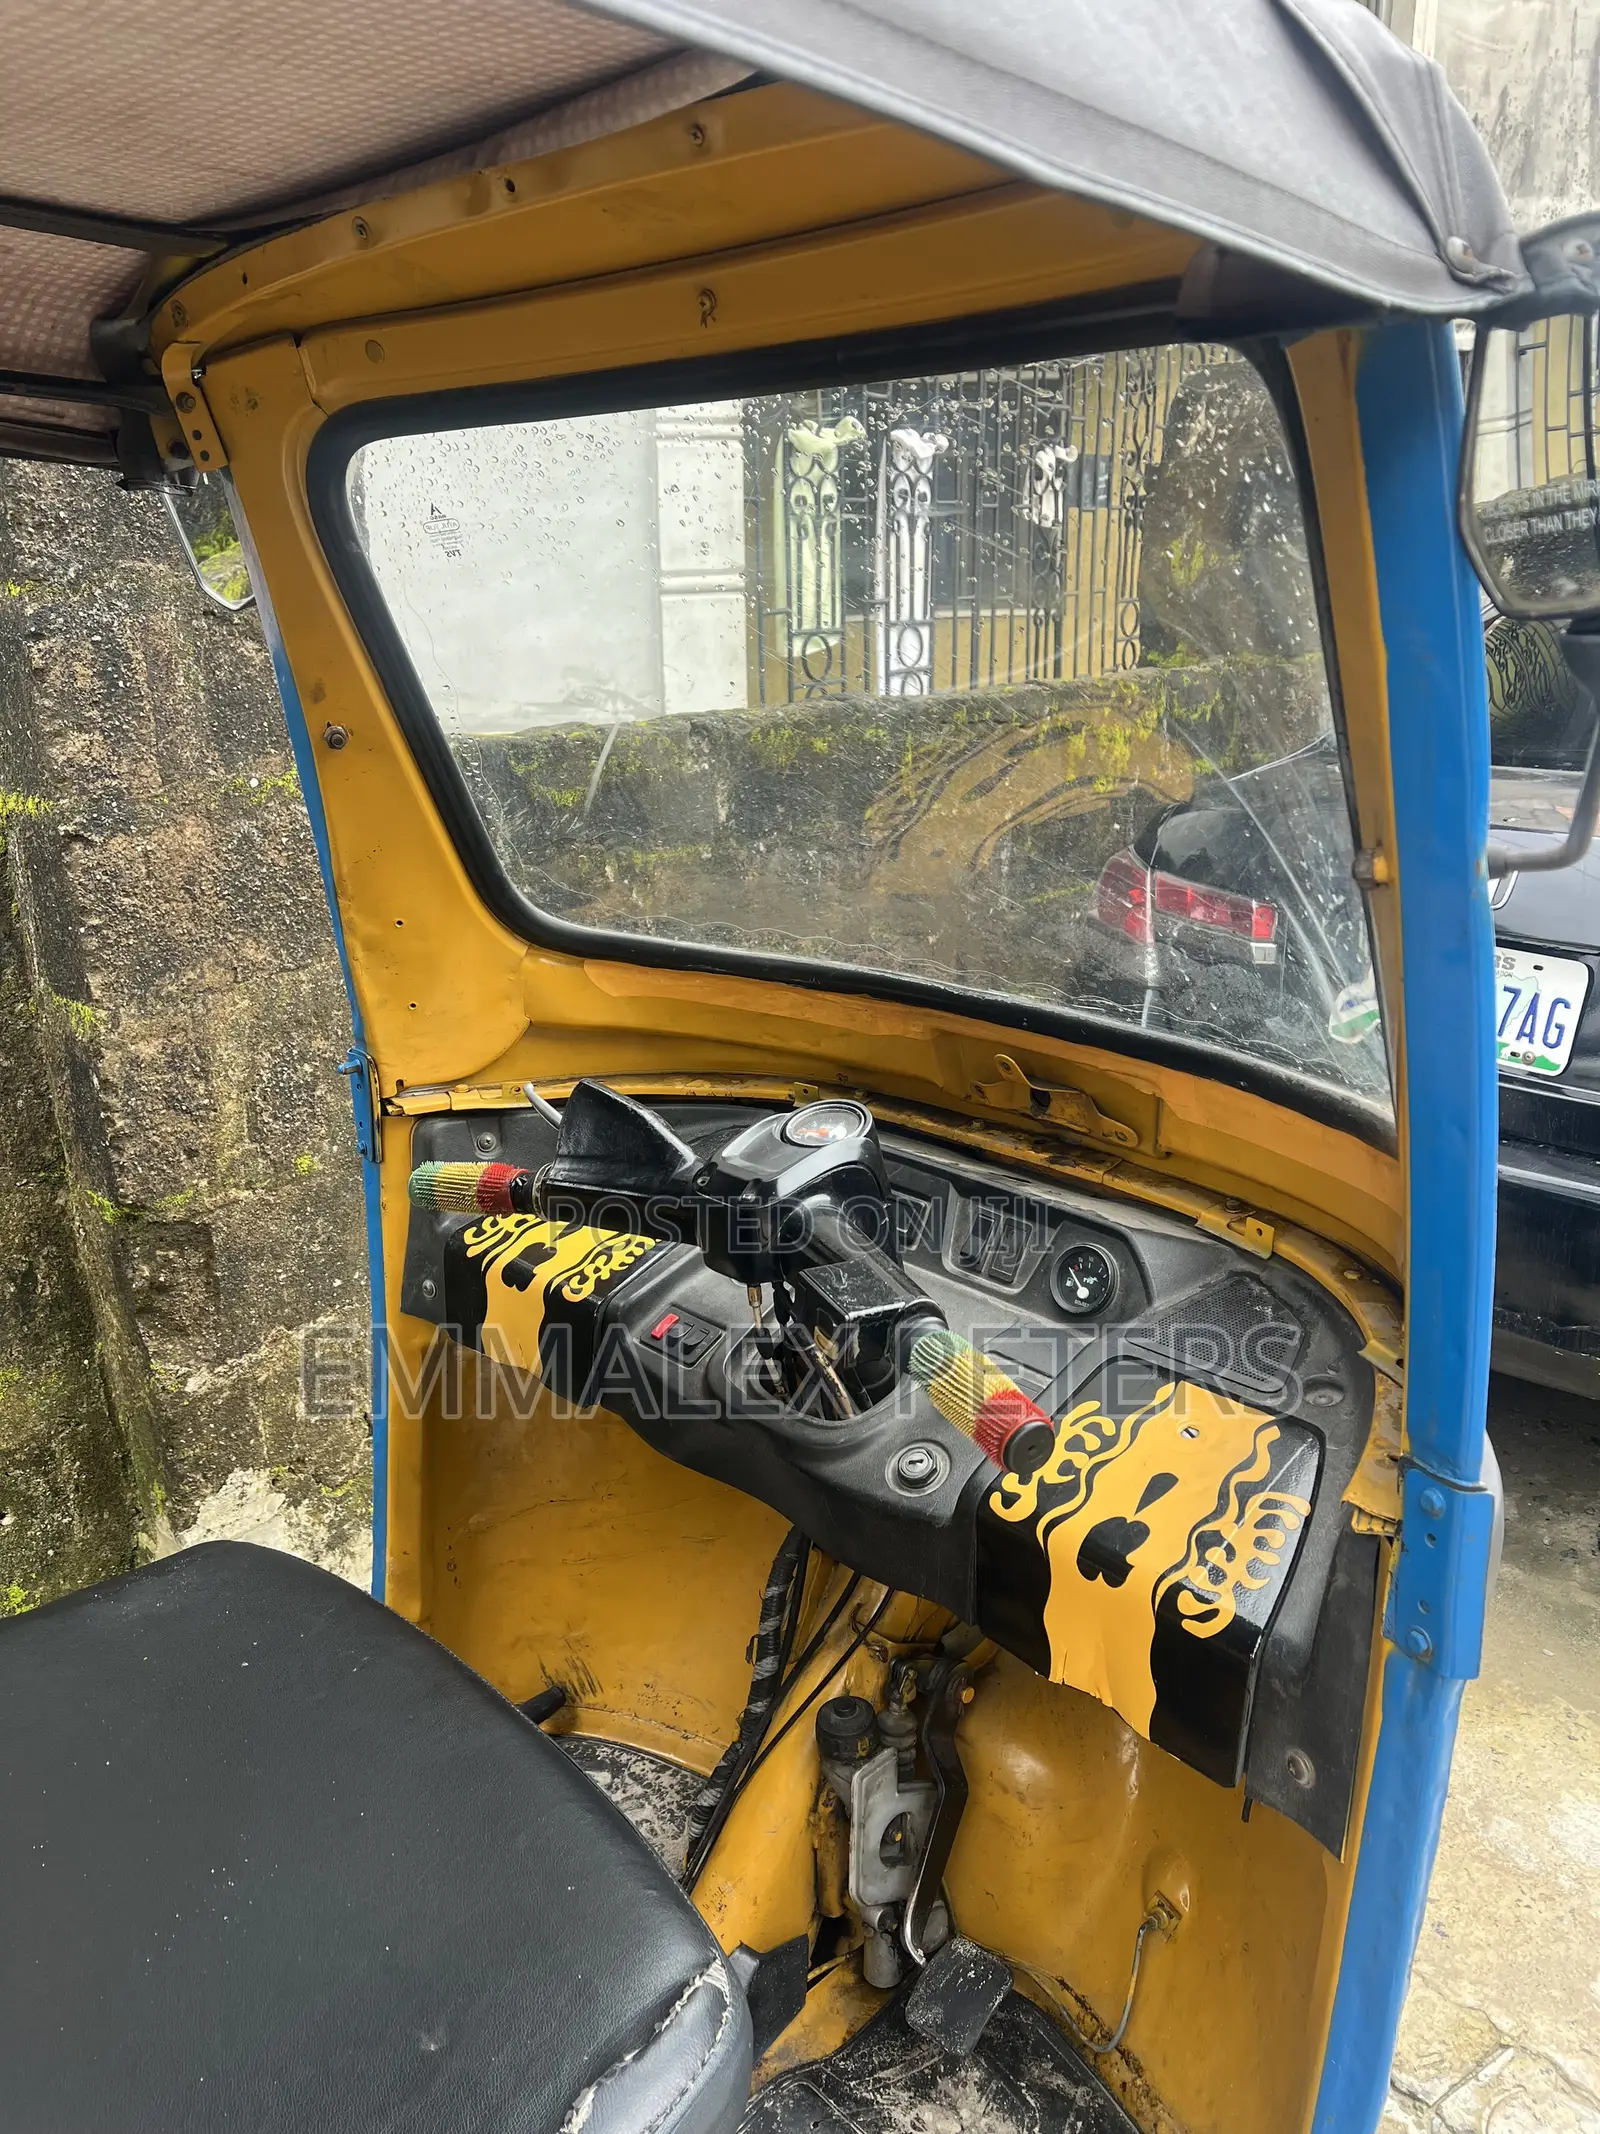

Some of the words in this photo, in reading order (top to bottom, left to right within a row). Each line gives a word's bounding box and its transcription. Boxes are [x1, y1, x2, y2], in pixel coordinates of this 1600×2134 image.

[1530, 492, 1545, 508] IN
[1545, 484, 1572, 504] THE
[1572, 478, 1600, 500] MIR
[1484, 520, 1530, 543] CLOSER
[1530, 513, 1563, 535] THAN
[1563, 506, 1598, 530] THEY
[1497, 985, 1571, 1049] 7AG
